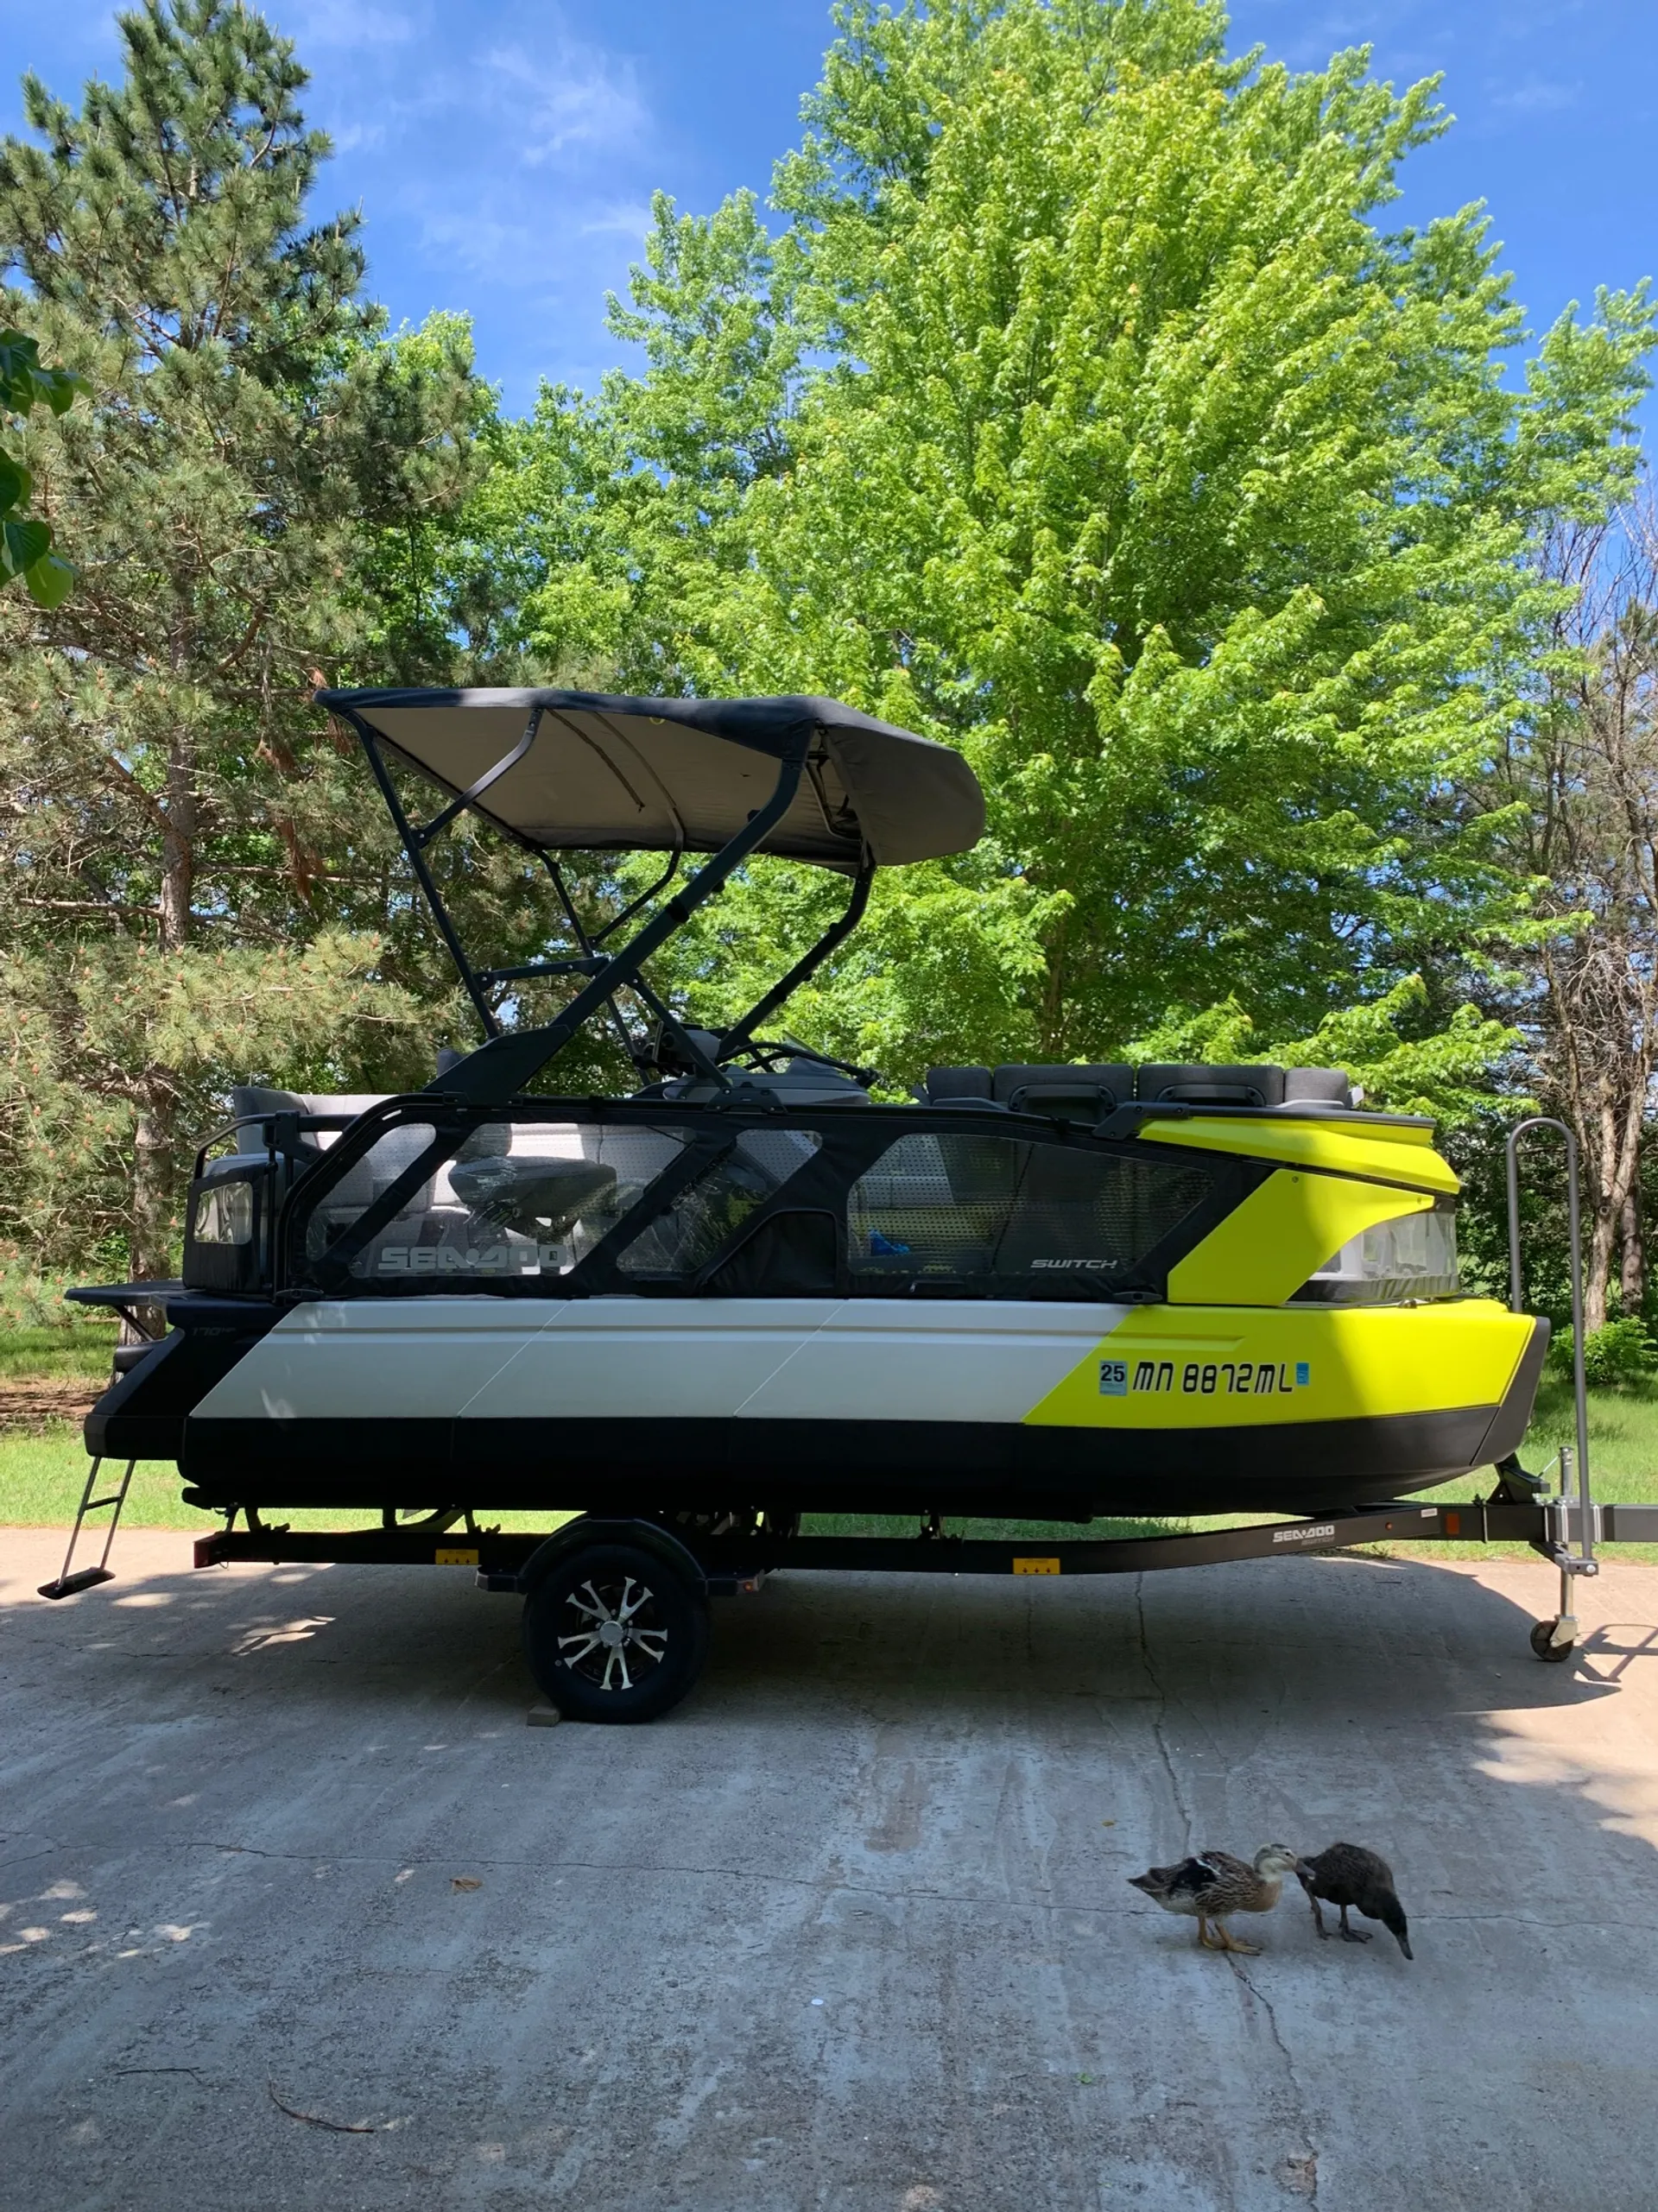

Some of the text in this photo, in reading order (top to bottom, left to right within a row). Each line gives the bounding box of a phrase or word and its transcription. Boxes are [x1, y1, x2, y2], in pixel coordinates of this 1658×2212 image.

[1030, 1259, 1118, 1269] SWITCH
[1100, 1364, 1125, 1383] 25
[1182, 1362, 1294, 1394] 8872ML
